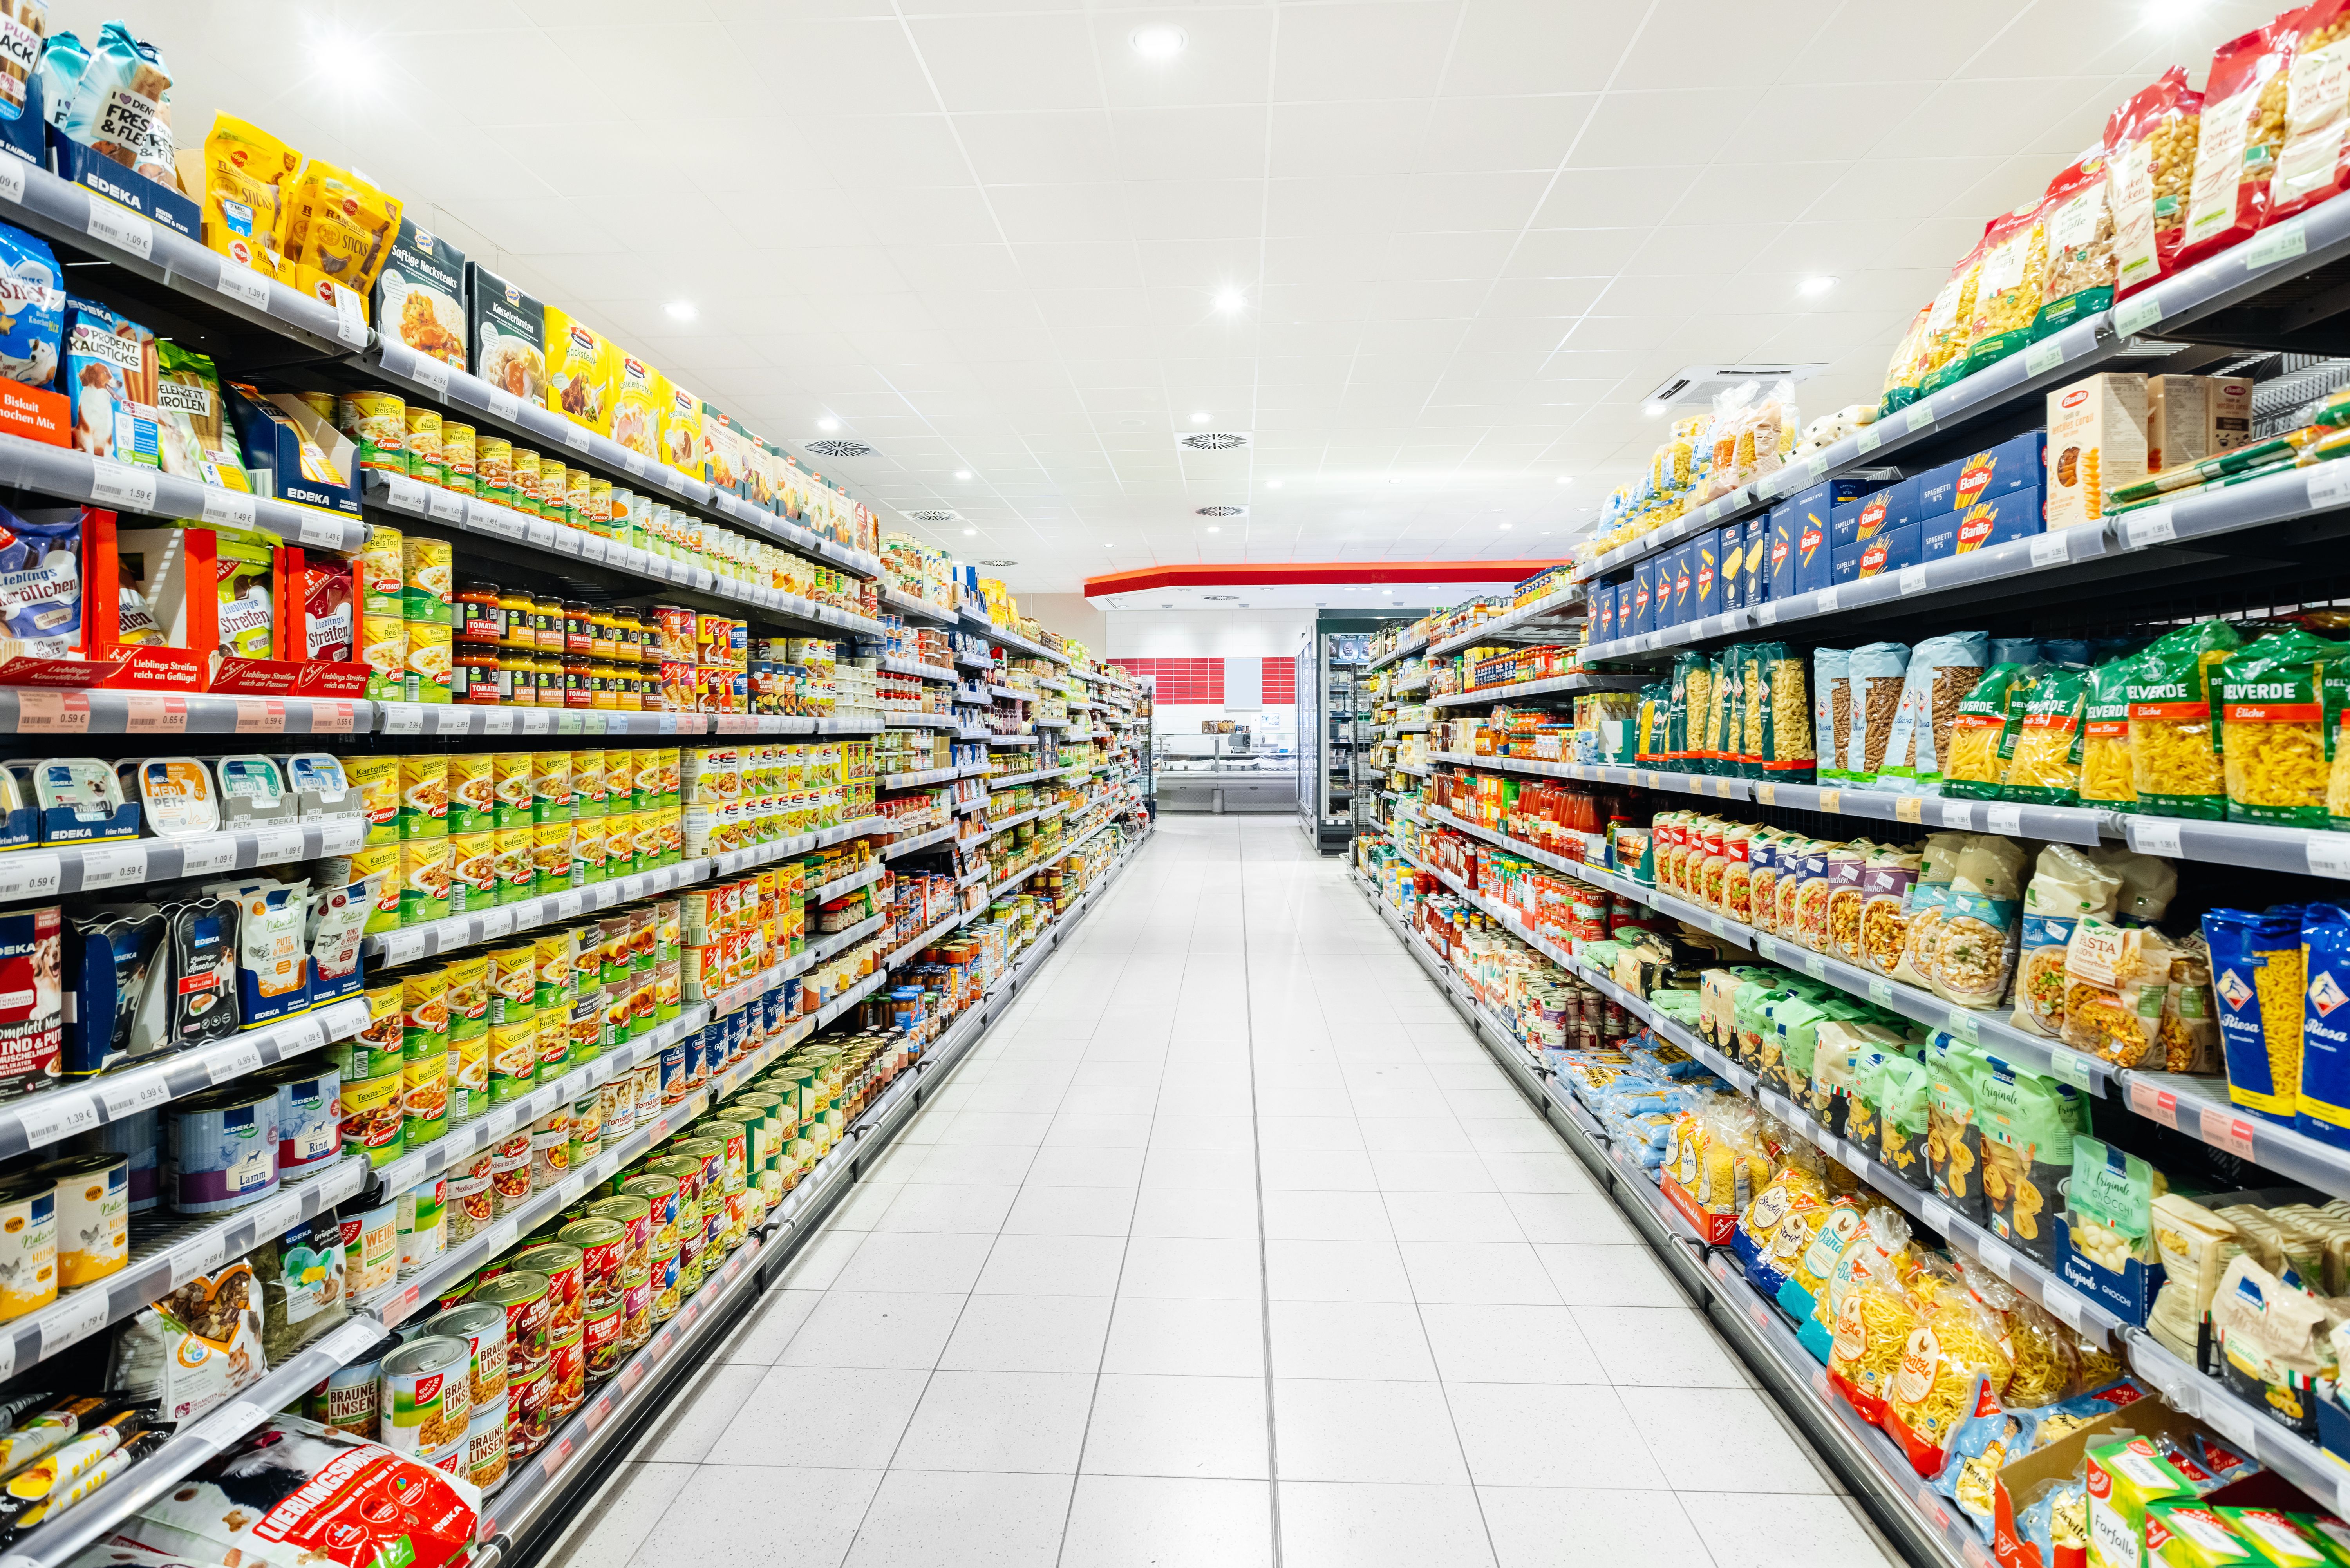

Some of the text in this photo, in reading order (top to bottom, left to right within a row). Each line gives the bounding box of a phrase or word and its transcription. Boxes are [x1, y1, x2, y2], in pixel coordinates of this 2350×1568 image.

[4, 21, 37, 49] PLUS
[225, 148, 254, 167] Pedigree
[217, 160, 261, 189] RANCHOS
[87, 172, 141, 210] EDEKA
[242, 188, 271, 211] STICKS
[339, 198, 364, 215] Pedigree
[155, 207, 173, 220] DENTAL
[325, 209, 365, 236] RANCHOS
[126, 233, 141, 246] 1.09
[342, 235, 368, 257] STICKS
[2281, 239, 2295, 249] 2.19
[228, 242, 253, 262] Pedigree
[392, 245, 419, 268] Saftige
[421, 259, 457, 290] Hacksteaks
[248, 287, 260, 298] 1.39
[67, 300, 112, 326] EDEKA
[493, 302, 533, 333] Kasselerbraten
[91, 330, 138, 354] PRODENT
[69, 337, 139, 367] KAUSTICKS
[566, 347, 597, 367] Hacksteak
[434, 375, 443, 385] 2.19
[619, 382, 653, 397] Kasselerbraten
[4, 394, 39, 412] Biskuit
[2063, 391, 2088, 407] Barilla
[0, 409, 55, 430] nochen Mix
[668, 410, 699, 429] Rostbratwürstchen
[2052, 413, 2094, 435] lentilles corail
[378, 439, 401, 449] Erasco
[1959, 471, 1989, 490] Barilla
[130, 488, 145, 499] 1.59
[287, 488, 330, 506] EDEKA
[1924, 483, 1951, 499] SPAGHETTI
[1933, 494, 1942, 503] N°5
[1800, 495, 1813, 505] GIRANDOLE
[234, 512, 246, 521] 1.49
[1835, 518, 1855, 530] CAPELLINI
[1862, 509, 1884, 524] Barilla
[1960, 523, 1990, 541] Barilla
[2152, 524, 2164, 533] 1.99
[370, 539, 398, 547] Reis-Topf
[1801, 534, 1820, 547] Barilla
[1926, 532, 1952, 545] SPAGHETTI
[223, 600, 259, 614] Lieblings
[220, 609, 270, 633] Streifen
[315, 615, 344, 629] Lieblings
[309, 626, 349, 648] Streifen
[134, 659, 197, 671] Lieblings Streifen
[167, 672, 196, 684] Geflügel
[242, 671, 295, 680] Lieblings Streifen
[322, 672, 345, 682] Lieblings
[60, 714, 85, 723] 0.59 €
[163, 716, 178, 724] 0.65
[2236, 708, 2265, 718] Eliche
[151, 785, 181, 796] MEDI
[154, 797, 185, 808] PET+
[268, 817, 294, 826] EDEKA
[369, 810, 395, 823] Erasco
[51, 828, 92, 840] EDEKA
[2160, 840, 2171, 848] 1.99
[120, 867, 136, 876] 0.59
[346, 927, 358, 937] RIND
[195, 936, 220, 946] EDEKA
[276, 936, 291, 946] PUTE
[2079, 934, 2116, 955] PASTA
[279, 943, 294, 955] HUHN
[314, 990, 336, 1000] EDEKA
[255, 1009, 279, 1020] EDEKA
[539, 1010, 563, 1022] Rindfleisch
[540, 1014, 567, 1027] Nudel-Topf
[2221, 1013, 2260, 1033] Riesa
[2305, 1018, 2347, 1042] Riesa
[544, 1049, 565, 1061] Erasco
[2077, 1061, 2088, 1072] BIO
[141, 1088, 157, 1100] 0.99
[356, 1082, 395, 1102] Texas-Topf
[1982, 1080, 2019, 1105] Originale
[292, 1095, 319, 1106] EDEKA
[67, 1113, 84, 1124] 1.39
[224, 1122, 255, 1134] EDEKA
[369, 1127, 397, 1145] Erasco
[309, 1140, 327, 1153] Rind
[239, 1171, 266, 1186] Lamm
[2097, 1172, 2130, 1196] Originale
[456, 1182, 484, 1193] Mexikanisches
[1669, 1183, 1701, 1224] Frischei-Nudeln
[2092, 1189, 2133, 1216] GNOCCHI
[5, 1219, 23, 1228] HUHN
[1716, 1220, 1734, 1237] GÜNSTIG
[286, 1225, 338, 1244] EDEKA Grünzeug
[366, 1240, 396, 1259] BOHNEN
[587, 1248, 606, 1268] GÜNSTIG
[2072, 1255, 2092, 1271] EDEKA
[2064, 1262, 2131, 1308] Originale GNOCCHI
[2236, 1288, 2263, 1306] EDEKA
[530, 1295, 549, 1315] CHILI
[81, 1317, 97, 1330] 1.79
[589, 1316, 617, 1335] FEUER
[597, 1329, 610, 1338] TOPF
[174, 1368, 208, 1384] NAGERFUTTER
[330, 1383, 374, 1403] BRAUNE
[418, 1377, 439, 1401] GÜNSTIG
[330, 1397, 375, 1417] LINSEN
[342, 1412, 372, 1424] Suppengrün
[470, 1424, 503, 1451] BRAUNE
[1913, 1434, 1931, 1447] EDEKA
[262, 1446, 392, 1540] LIEBLINGSMENÜ
[2095, 1514, 2134, 1559] Farfalle
